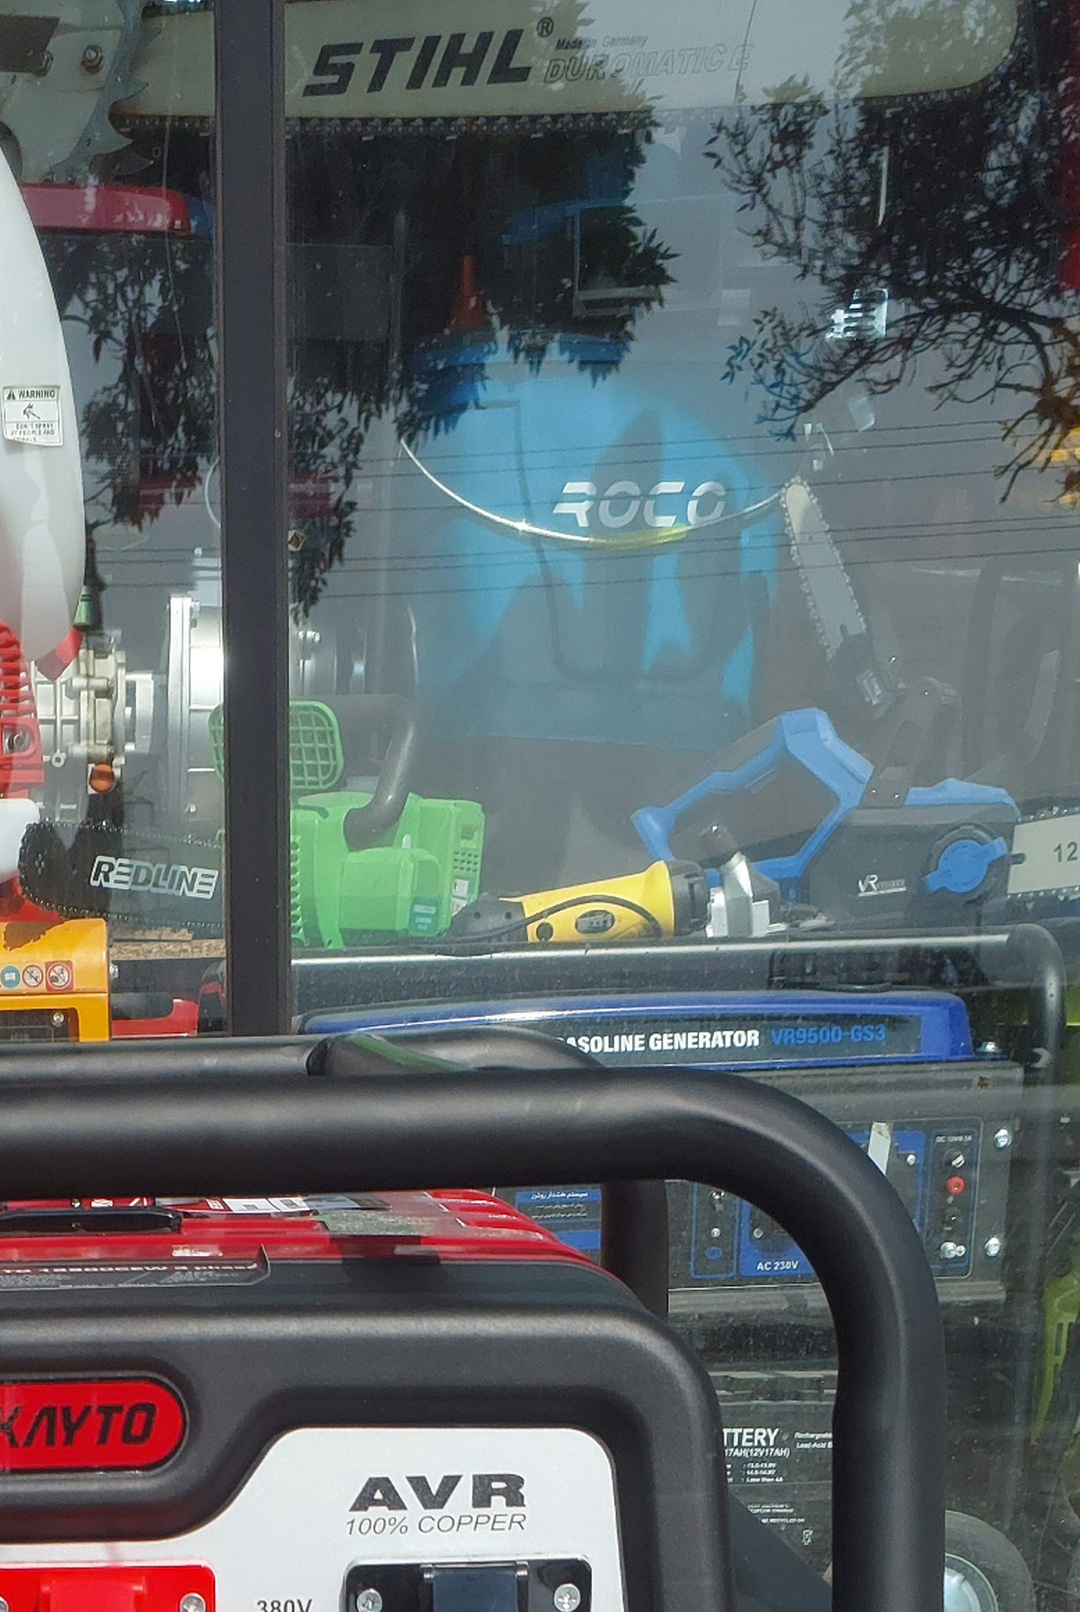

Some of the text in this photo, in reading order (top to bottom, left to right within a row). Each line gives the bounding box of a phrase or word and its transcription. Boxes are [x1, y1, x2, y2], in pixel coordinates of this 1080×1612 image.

[555, 38, 583, 50] Made
[601, 35, 649, 48] Germany
[302, 28, 536, 98] STIHL
[544, 43, 728, 83] DUROMATIC
[18, 389, 56, 400] WARNING
[552, 480, 727, 529] ROCO
[89, 855, 219, 900] REDLINE
[557, 1023, 886, 1054] ASOLINE GENERATOR VR9500-GS3
[756, 1260, 799, 1271] AC 230V
[722, 1427, 780, 1447] TTERY
[348, 1473, 527, 1513] AVR
[345, 1513, 527, 1536] 100% COPPER
